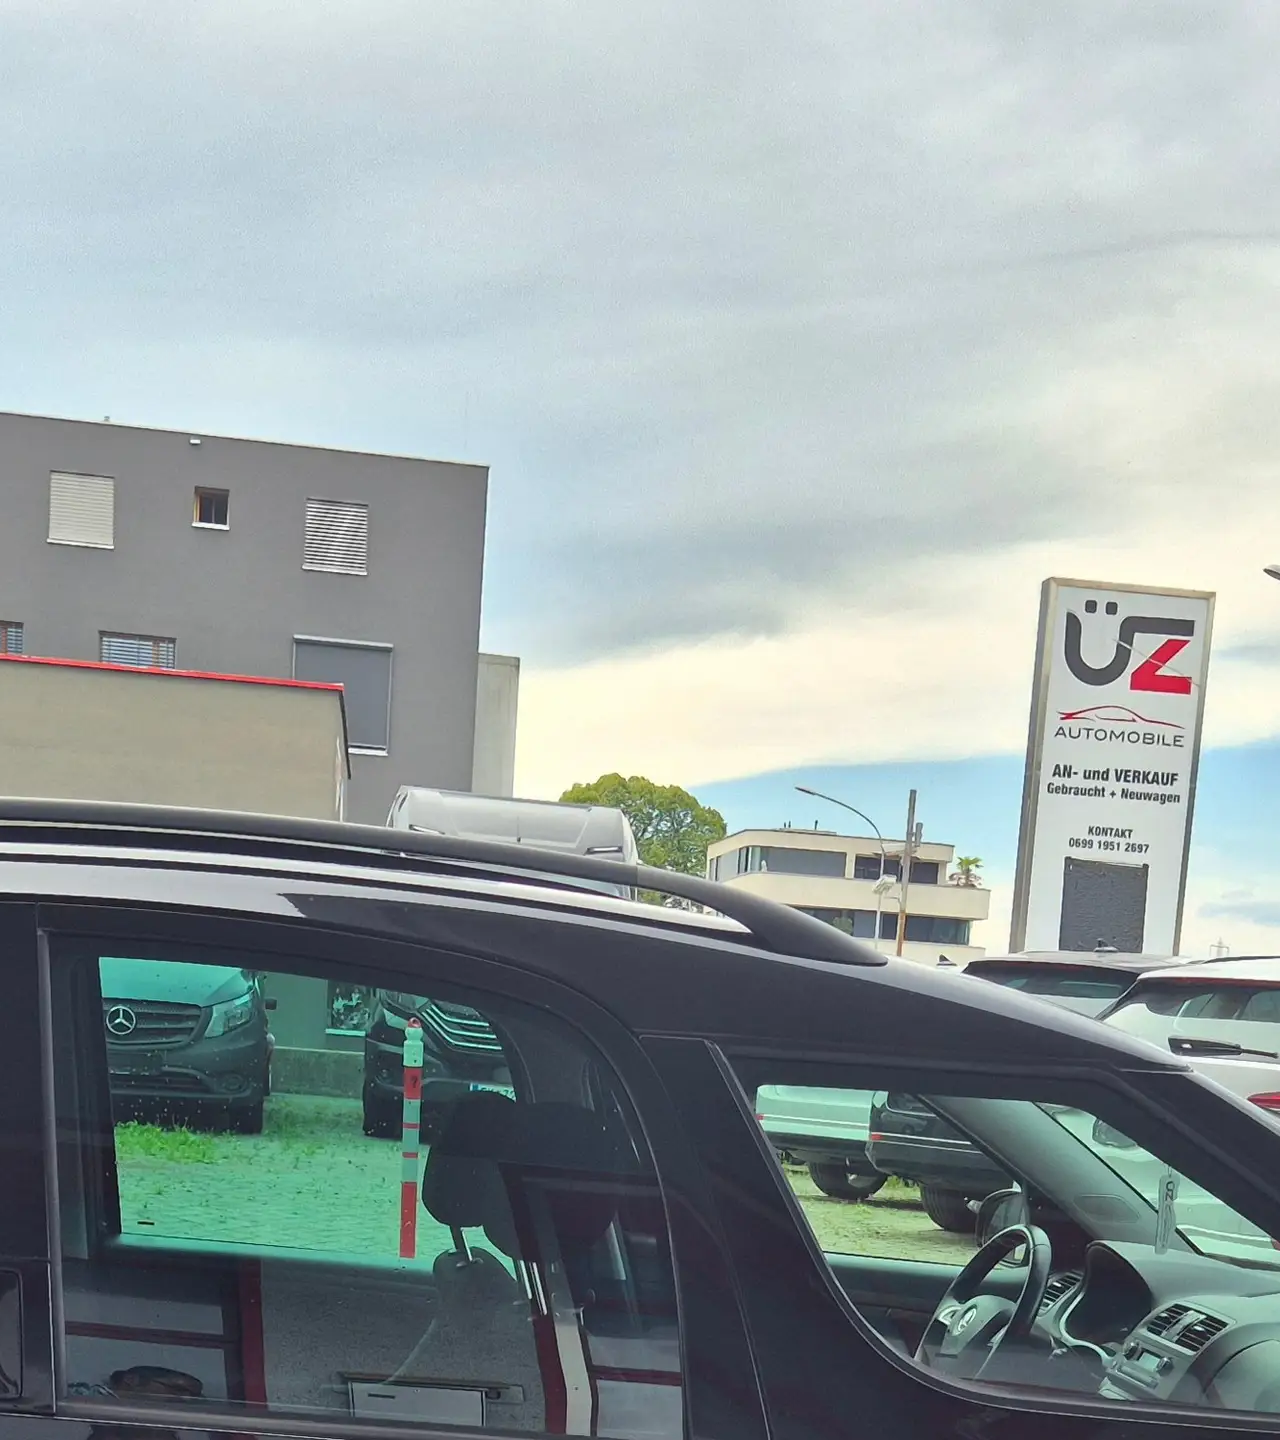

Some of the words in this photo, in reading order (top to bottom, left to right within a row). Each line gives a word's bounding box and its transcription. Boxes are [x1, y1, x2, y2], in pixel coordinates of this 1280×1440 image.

[1064, 600, 1195, 695] ÜZ
[1054, 726, 1185, 748] AUTOMOBILE
[1051, 763, 1079, 779] AN-
[1083, 767, 1110, 782] und
[1114, 768, 1179, 787] VERKAUF
[1046, 781, 1106, 798] Gebraucht
[1109, 790, 1117, 799] +
[1120, 788, 1181, 806] Neuwagen
[1087, 825, 1134, 840] KONTAKT
[1068, 837, 1094, 850] 0699
[1097, 840, 1121, 852] 1951
[1124, 842, 1150, 854] 2697
